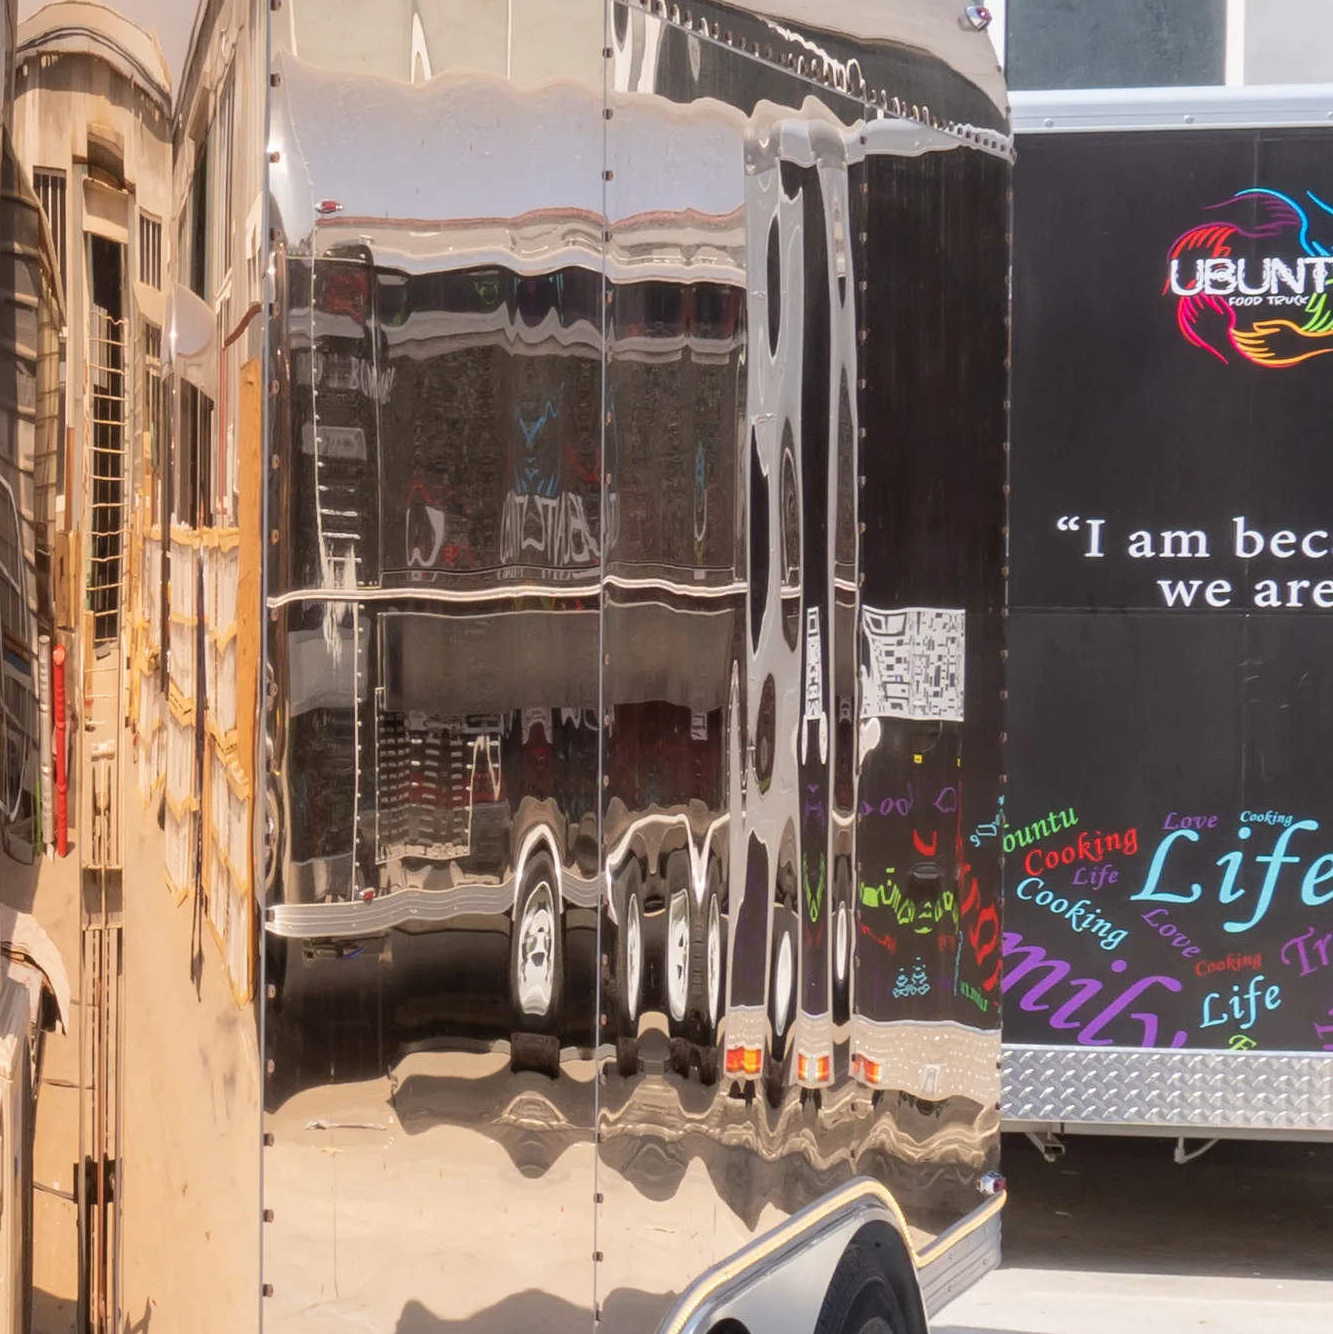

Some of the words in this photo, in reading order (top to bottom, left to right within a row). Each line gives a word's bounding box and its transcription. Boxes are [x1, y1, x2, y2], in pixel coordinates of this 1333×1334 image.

[1170, 257, 1333, 296] UBUNT
[1228, 296, 1263, 307] FOOD
[1267, 295, 1309, 307] TRUCK
[1128, 529, 1210, 558] am
[1232, 515, 1333, 559] bec
[1156, 578, 1232, 608] we
[1254, 578, 1333, 608] are
[1162, 811, 1218, 830] Love
[1240, 809, 1293, 827] Cooking
[1024, 826, 1139, 877] Cooking
[1072, 864, 1119, 890] Life
[1130, 819, 1333, 933] Life
[1016, 877, 1128, 950] Cooking
[1141, 908, 1201, 958] Love
[1194, 952, 1262, 977] Cooking
[1200, 974, 1282, 1030] Life
